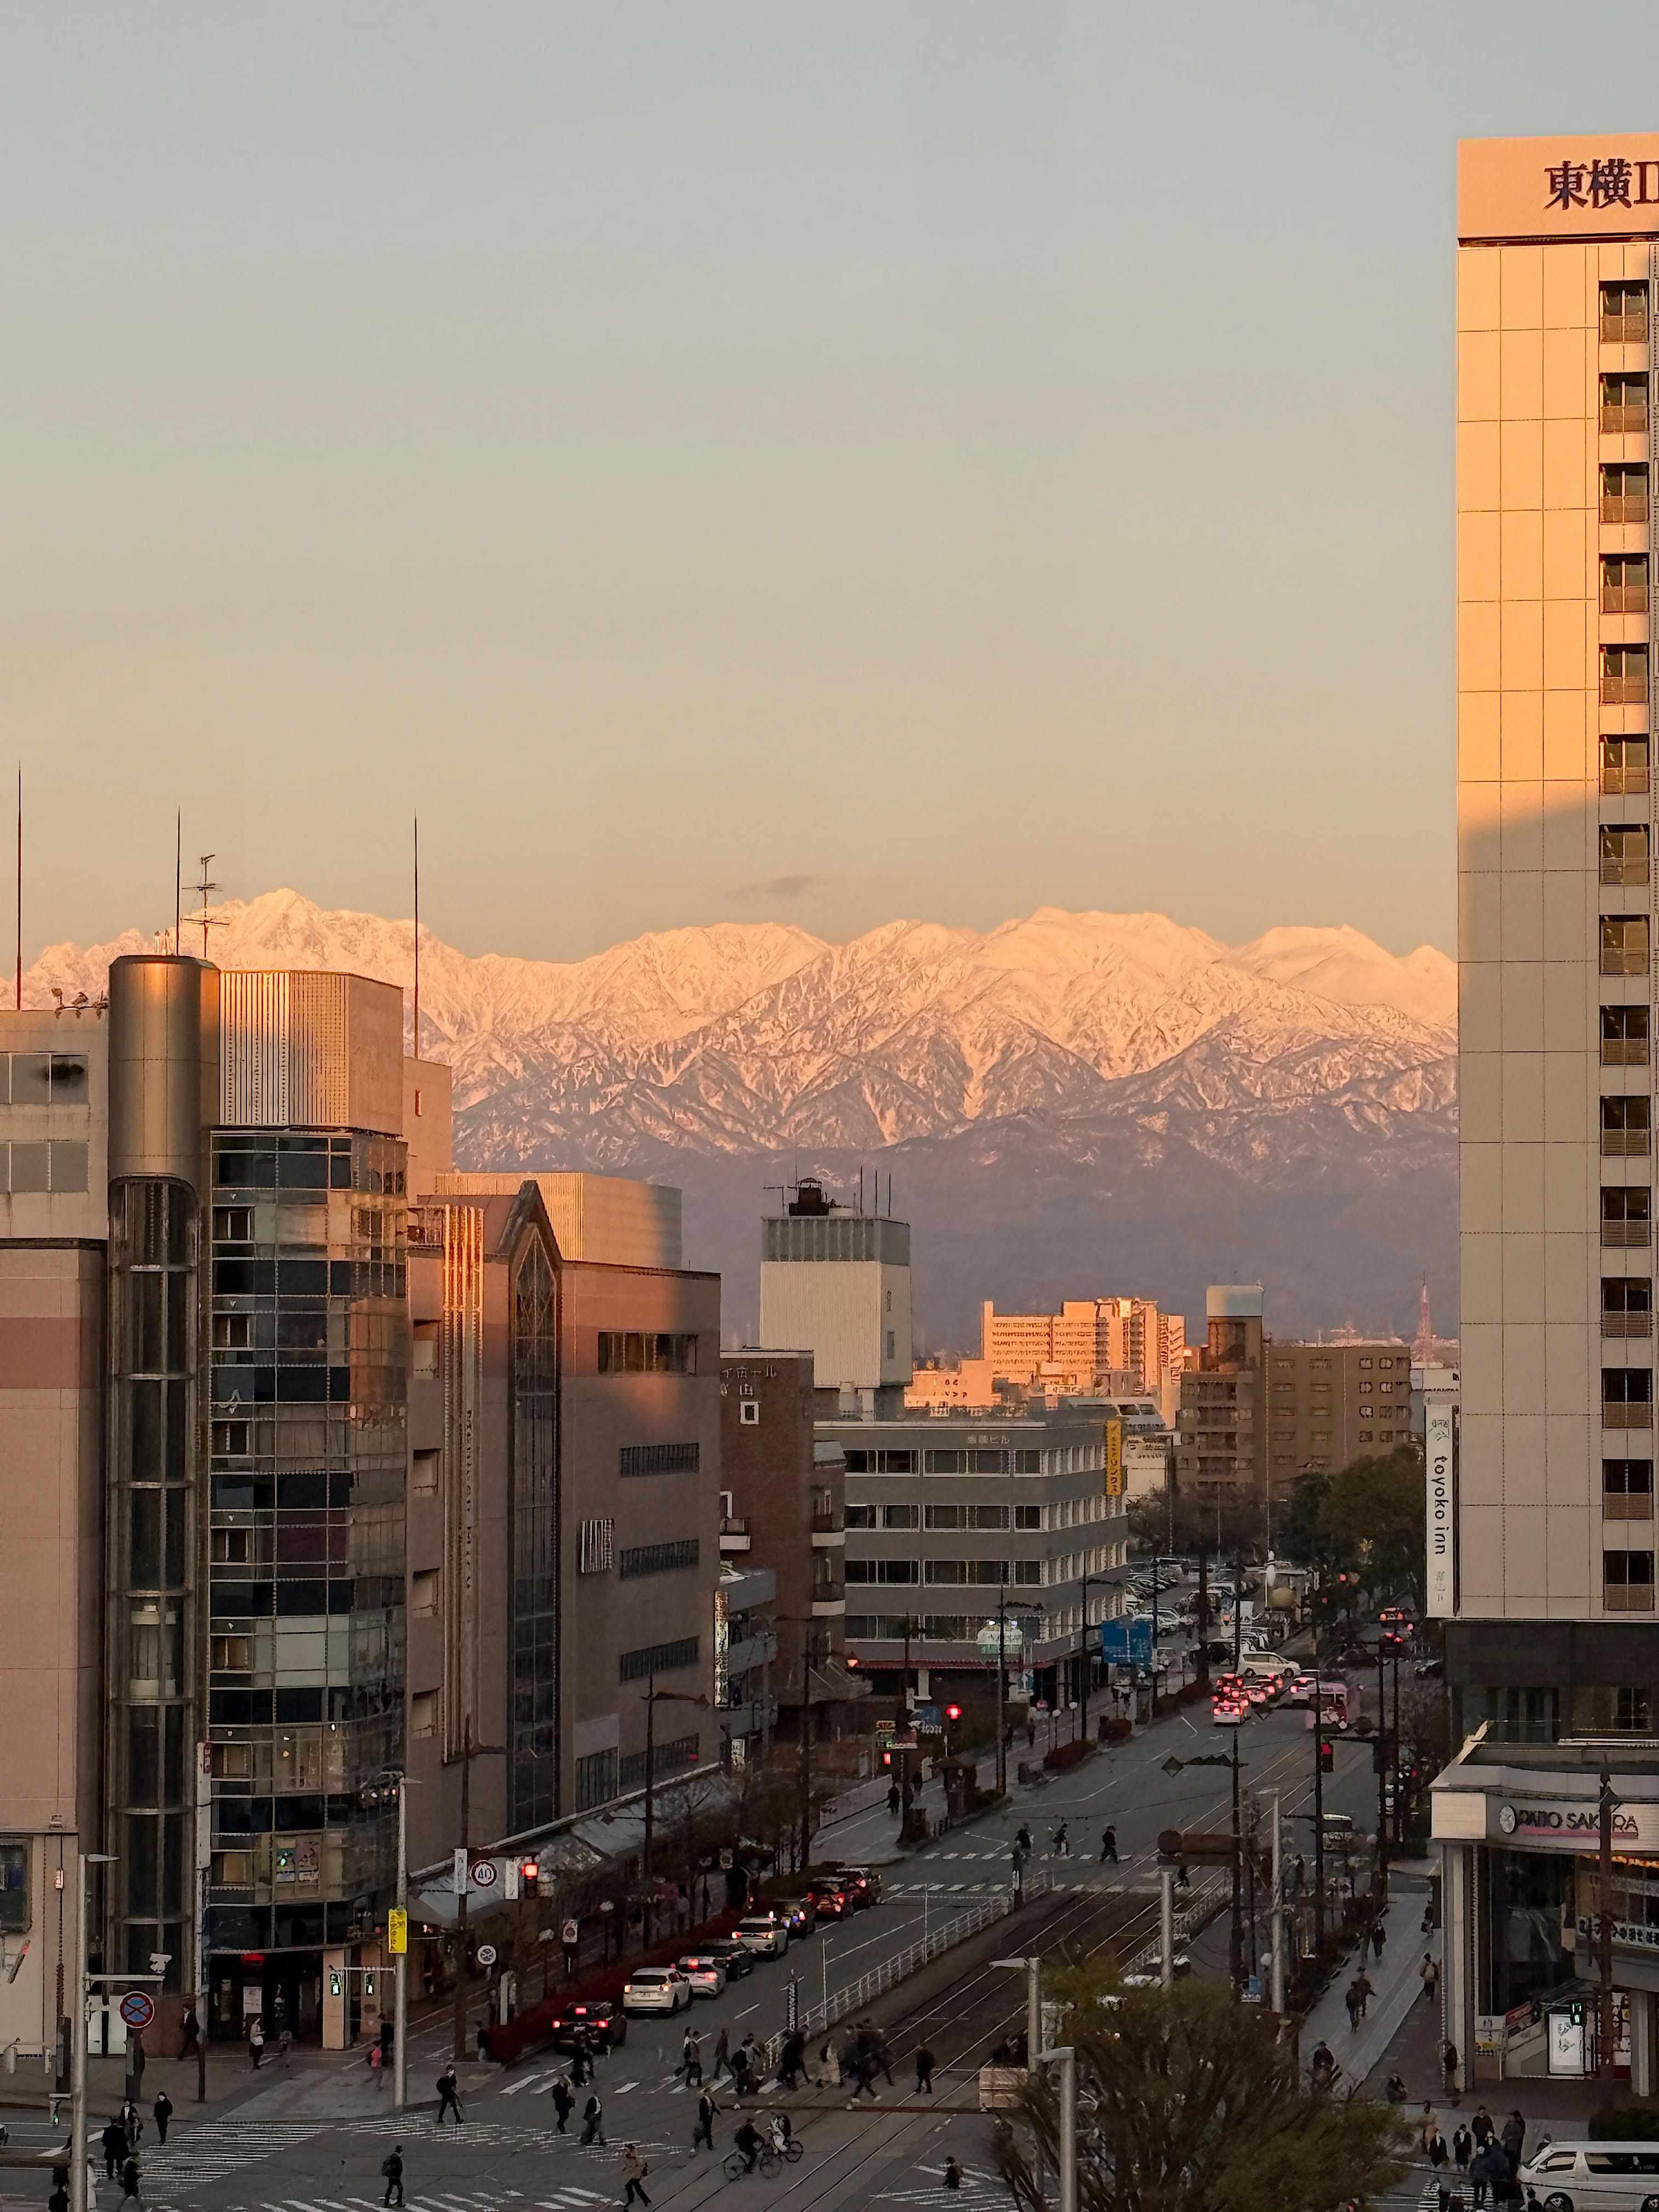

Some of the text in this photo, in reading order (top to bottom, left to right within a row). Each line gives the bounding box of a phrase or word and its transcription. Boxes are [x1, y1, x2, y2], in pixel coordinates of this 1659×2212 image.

[1543, 159, 1659, 210] 東横I
[1431, 1455, 1449, 1519] toyoko
[1435, 1527, 1449, 1554] inn
[1518, 1810, 1638, 1833] PATIO SAKRA
[478, 1867, 492, 1880] 40
